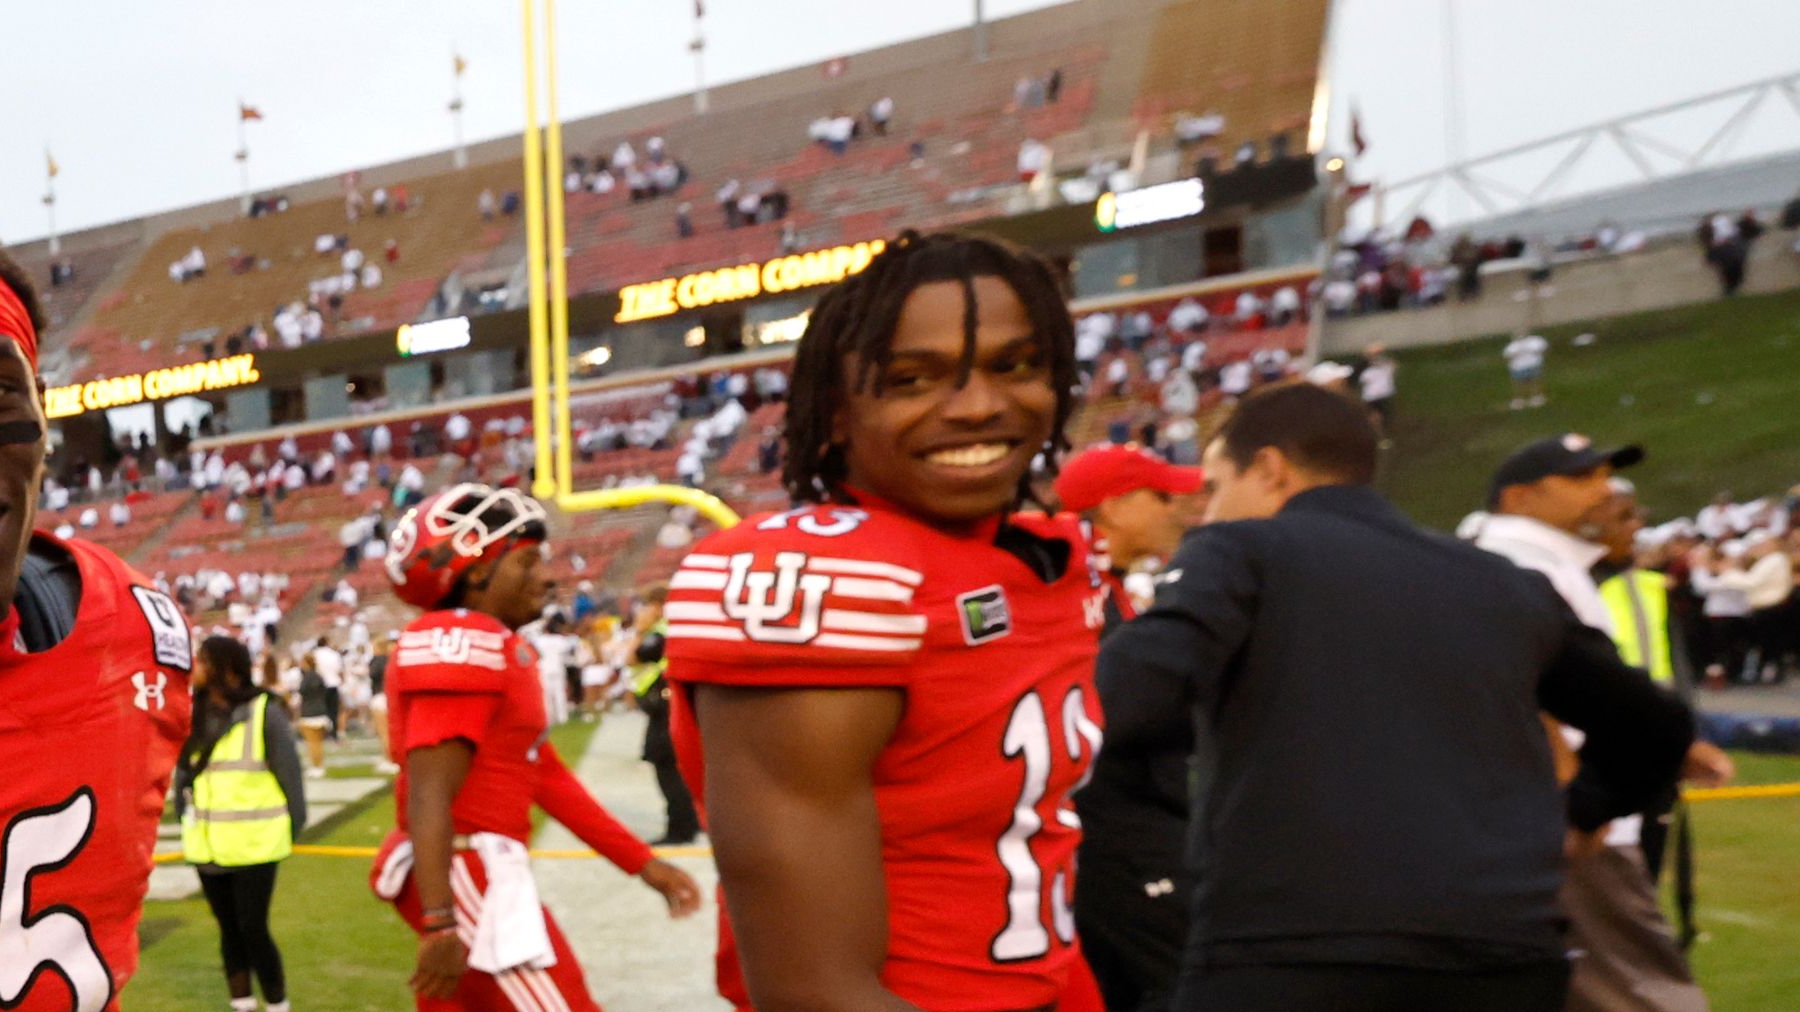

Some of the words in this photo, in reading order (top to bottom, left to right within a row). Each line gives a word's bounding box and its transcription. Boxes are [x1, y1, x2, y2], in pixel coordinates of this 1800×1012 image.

[614, 277, 679, 324] THE
[677, 262, 762, 309] CORN
[762, 239, 887, 293] COMPA
[83, 373, 144, 410] CORN
